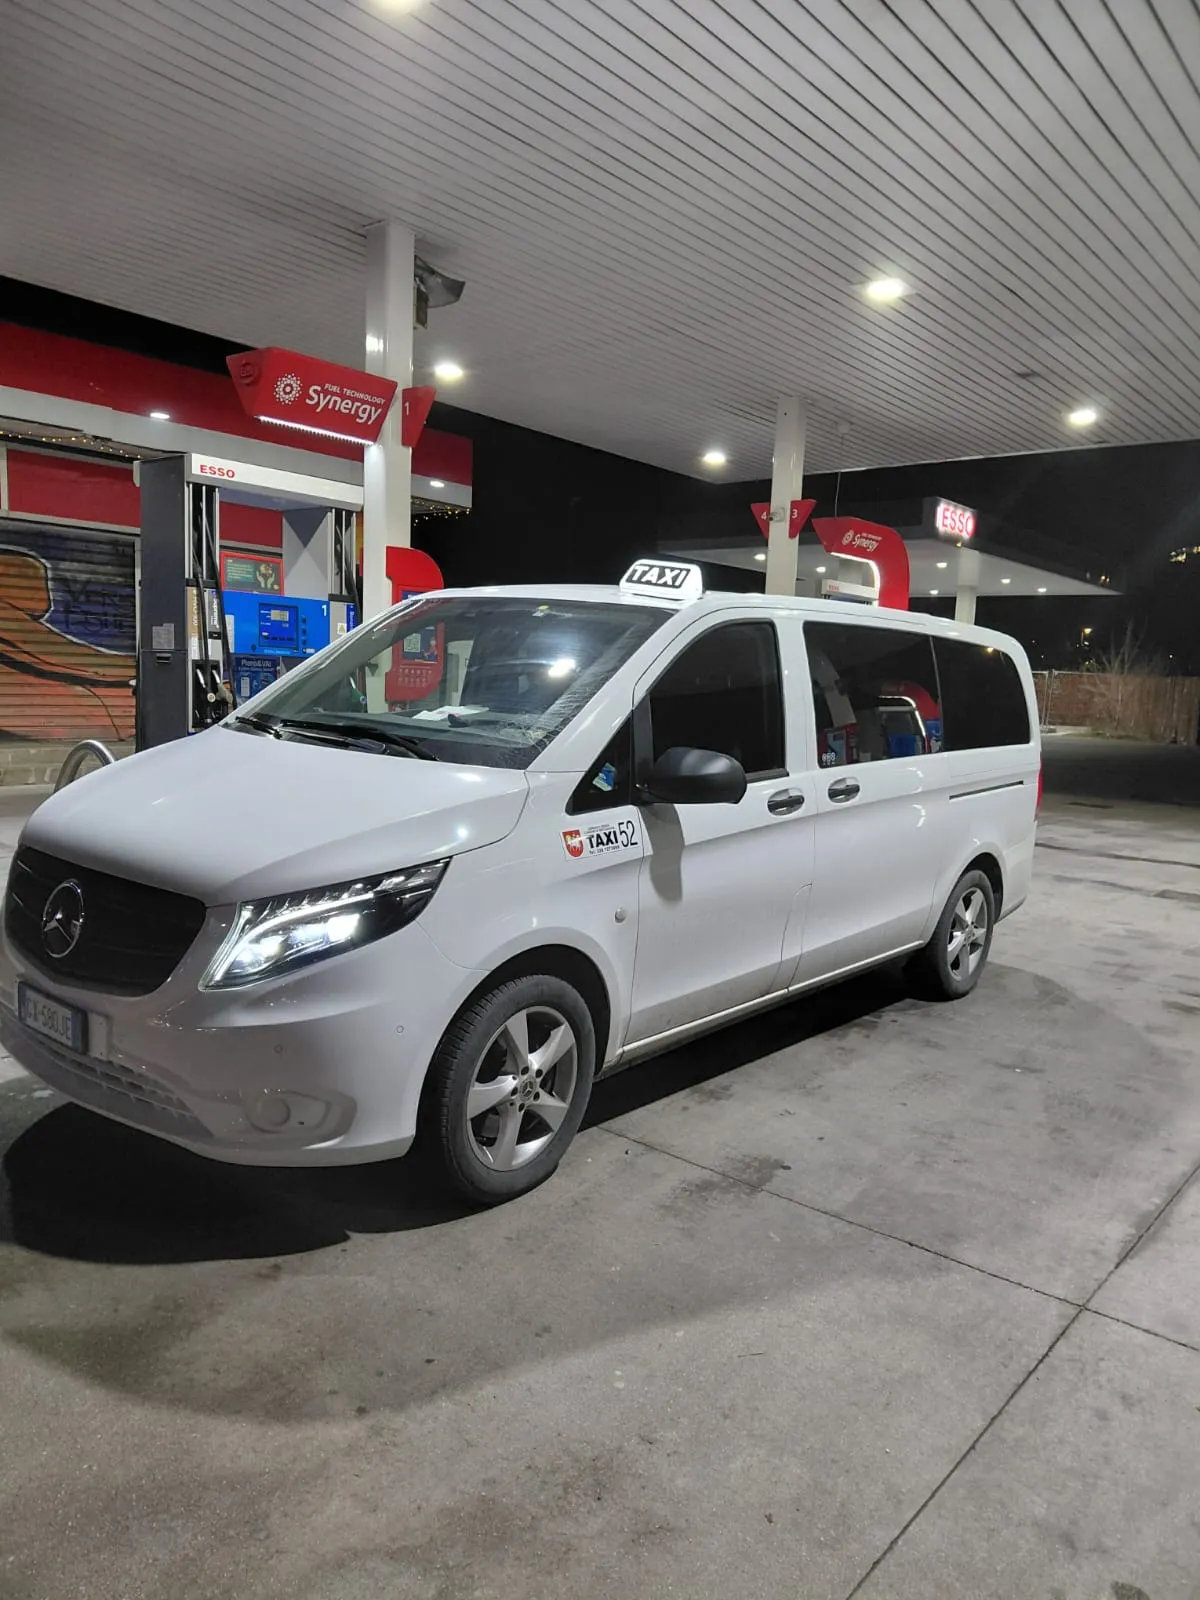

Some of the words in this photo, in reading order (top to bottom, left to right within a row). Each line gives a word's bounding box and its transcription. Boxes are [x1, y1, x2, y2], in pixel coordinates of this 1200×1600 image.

[324, 383, 341, 393] FUEL
[343, 387, 386, 405] TECHNOLOGY
[305, 385, 382, 425] Synergy
[403, 401, 410, 416] 1
[199, 464, 236, 479] ESSO
[760, 511, 767, 520] 4
[791, 508, 798, 519] 3
[941, 505, 976, 537] ESSO
[851, 533, 880, 553] Synergy
[631, 565, 688, 588] TAXI
[321, 604, 328, 617] 1
[587, 829, 619, 850] TAXI
[618, 820, 639, 848] 52
